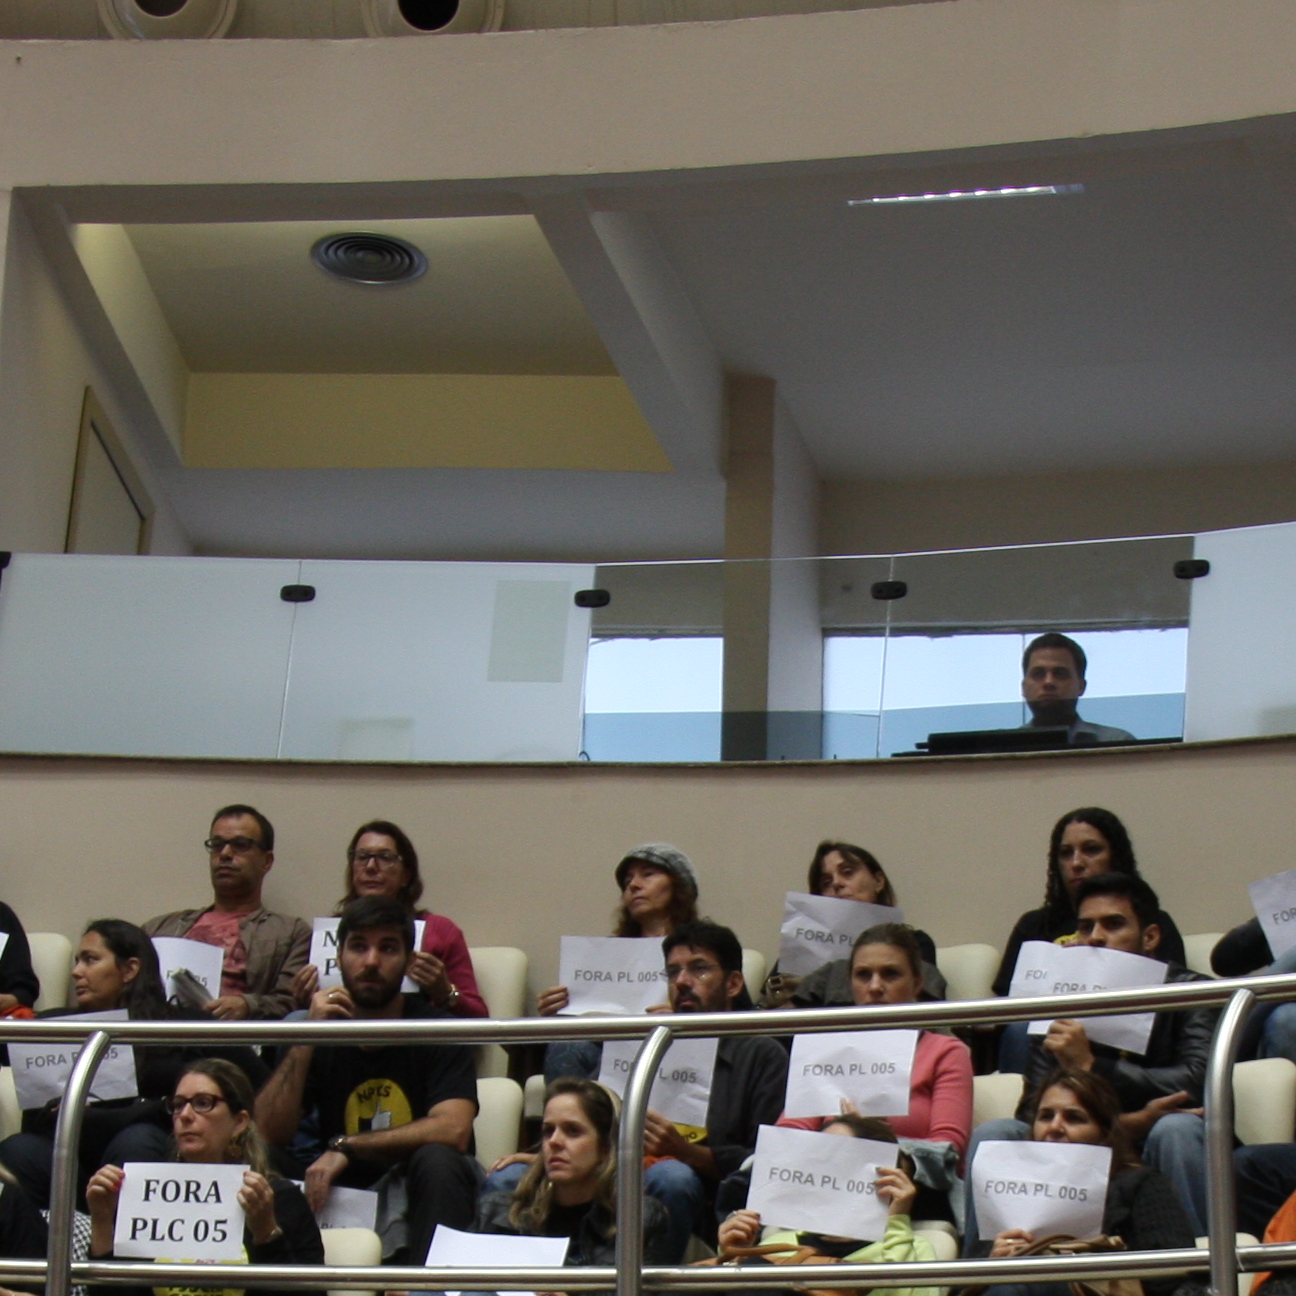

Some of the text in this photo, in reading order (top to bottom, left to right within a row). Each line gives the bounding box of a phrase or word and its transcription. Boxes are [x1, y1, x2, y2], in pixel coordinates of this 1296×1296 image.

[796, 928, 855, 947] FORA PL
[574, 969, 658, 982] FORA PL 005
[25, 1053, 67, 1069] FORA
[803, 1062, 896, 1076] FORA PL 005
[671, 1070, 696, 1083] 005
[768, 1167, 874, 1196] FORA PL 005
[984, 1180, 1088, 1202] FORA PL 005
[143, 1179, 222, 1204] FORA
[129, 1218, 228, 1242] PLC 05
